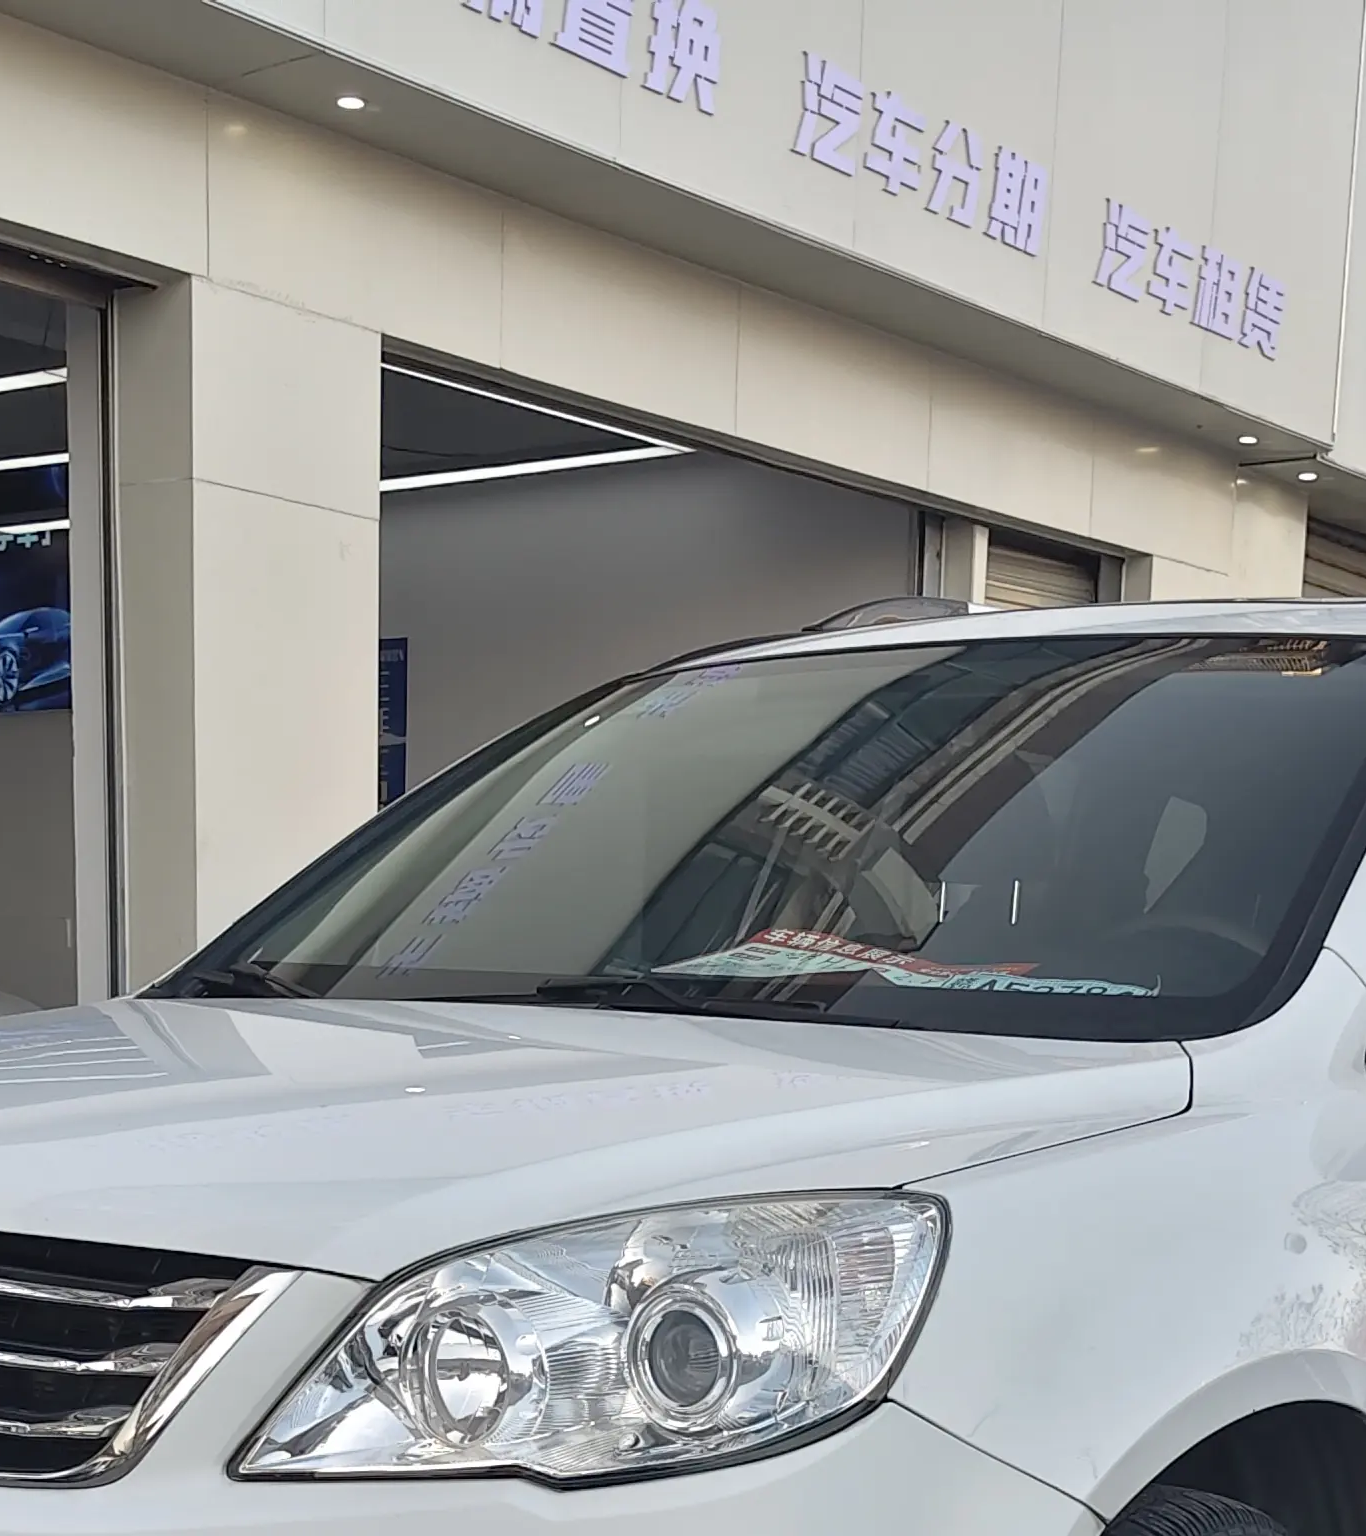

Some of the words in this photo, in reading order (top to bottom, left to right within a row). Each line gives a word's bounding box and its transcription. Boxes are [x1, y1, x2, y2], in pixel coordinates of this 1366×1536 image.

[792, 50, 1048, 258] 汽车分期
[1092, 197, 1287, 362] 汽车租赁
[762, 928, 917, 965] 车辆信息展示
